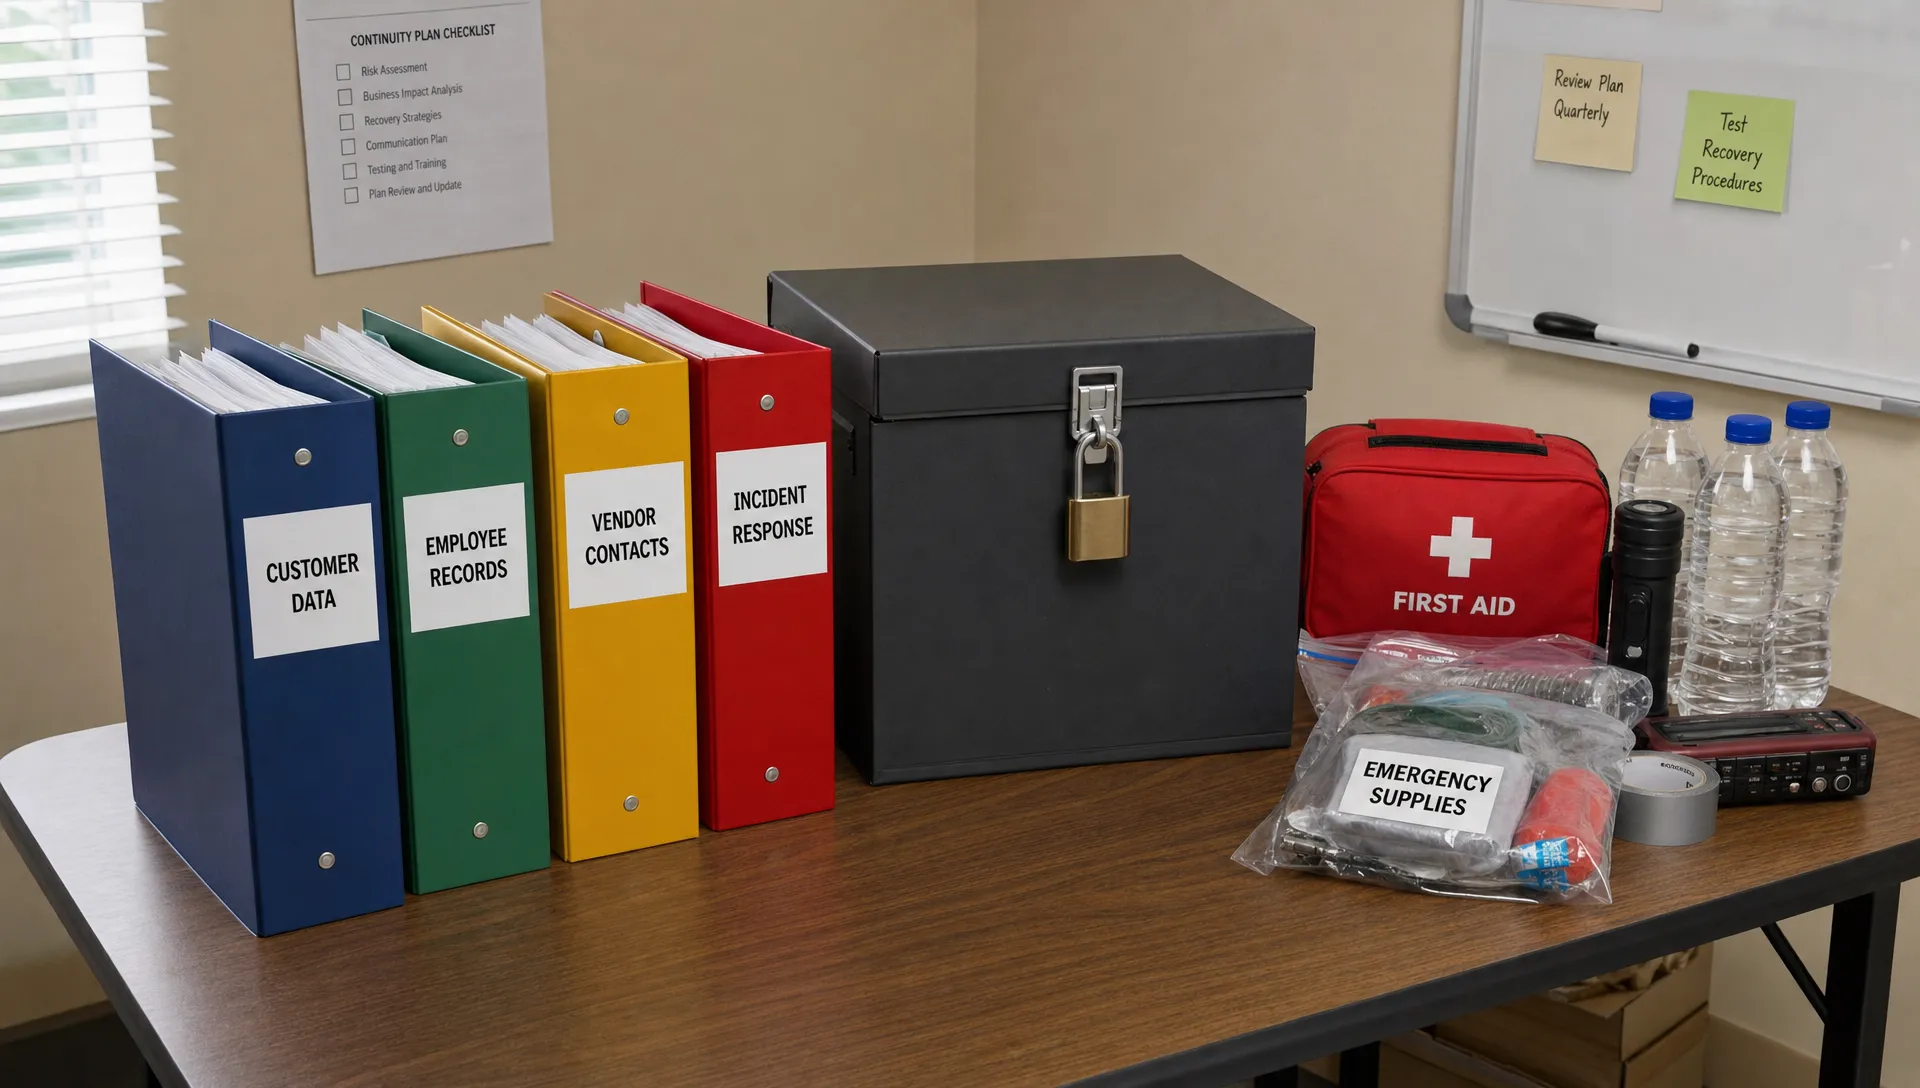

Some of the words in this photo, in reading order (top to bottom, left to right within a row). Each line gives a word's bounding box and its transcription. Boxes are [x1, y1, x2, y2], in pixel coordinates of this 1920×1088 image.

[351, 32, 412, 46] CONTINUITY
[415, 28, 440, 41] PLAN
[444, 24, 495, 39] CHECKLIST
[362, 66, 378, 76] Risk
[381, 62, 427, 75] Assessment
[1554, 69, 1592, 89] Review
[1599, 74, 1624, 93] Plan
[364, 90, 399, 101] Business
[402, 87, 429, 99] Impact
[431, 84, 462, 97] Analysis
[365, 114, 400, 127] Recovery
[403, 111, 442, 124] Strategies
[1554, 98, 1609, 127] Quarterly
[1720, 112, 1748, 133] Test
[366, 136, 428, 150] Communication
[431, 134, 447, 144] Plan
[1702, 139, 1762, 170] Recovery
[368, 164, 396, 176] Testing
[399, 161, 413, 172] and
[415, 158, 446, 170] Training
[369, 188, 386, 199] Plan
[388, 185, 415, 197] Review
[418, 183, 432, 193] and
[434, 180, 462, 193] Update
[1692, 167, 1762, 193] Procedures
[734, 485, 807, 511] INCIDENT
[592, 507, 656, 532] VENDOR
[733, 516, 813, 544] RESPONSE
[426, 528, 507, 556] EMPLOYEE
[586, 537, 669, 565] CONTACTS
[267, 553, 359, 583] CUSTOMER
[431, 559, 507, 587] RECORDS
[292, 589, 336, 613] DATA
[1393, 591, 1463, 613] FIRST
[1470, 596, 1515, 616] AID
[1364, 762, 1492, 793] EMERGENCY
[1369, 787, 1466, 816] SUPPLIES
